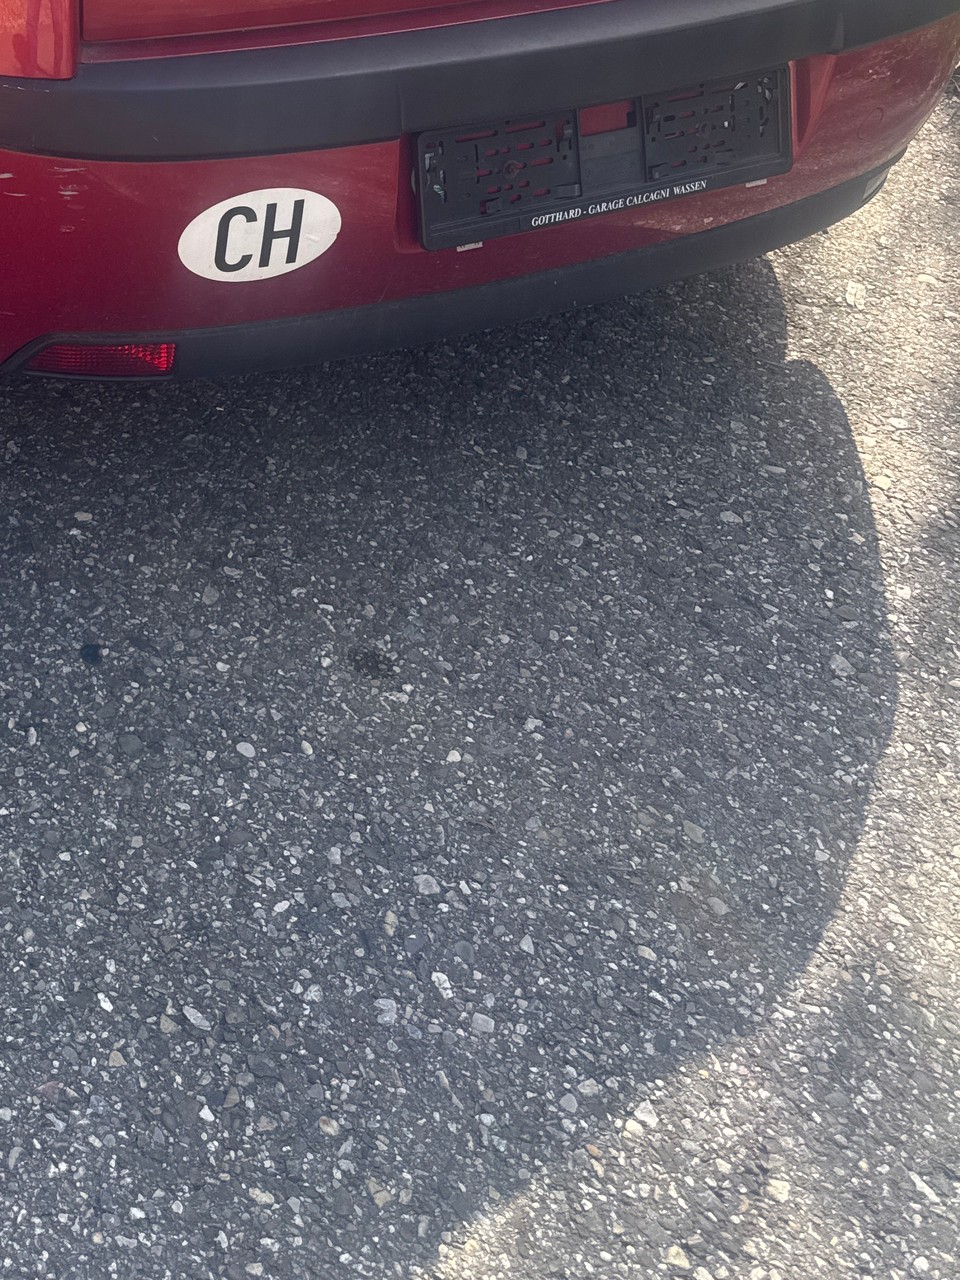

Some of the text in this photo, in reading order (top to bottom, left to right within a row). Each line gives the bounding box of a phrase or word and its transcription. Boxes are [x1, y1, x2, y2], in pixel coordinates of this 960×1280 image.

[531, 208, 582, 227] GOTTHARD
[588, 198, 625, 215] GARAGE
[626, 188, 671, 207] CALCAGNI
[673, 180, 708, 195] WASSEN
[214, 199, 305, 273] CH
